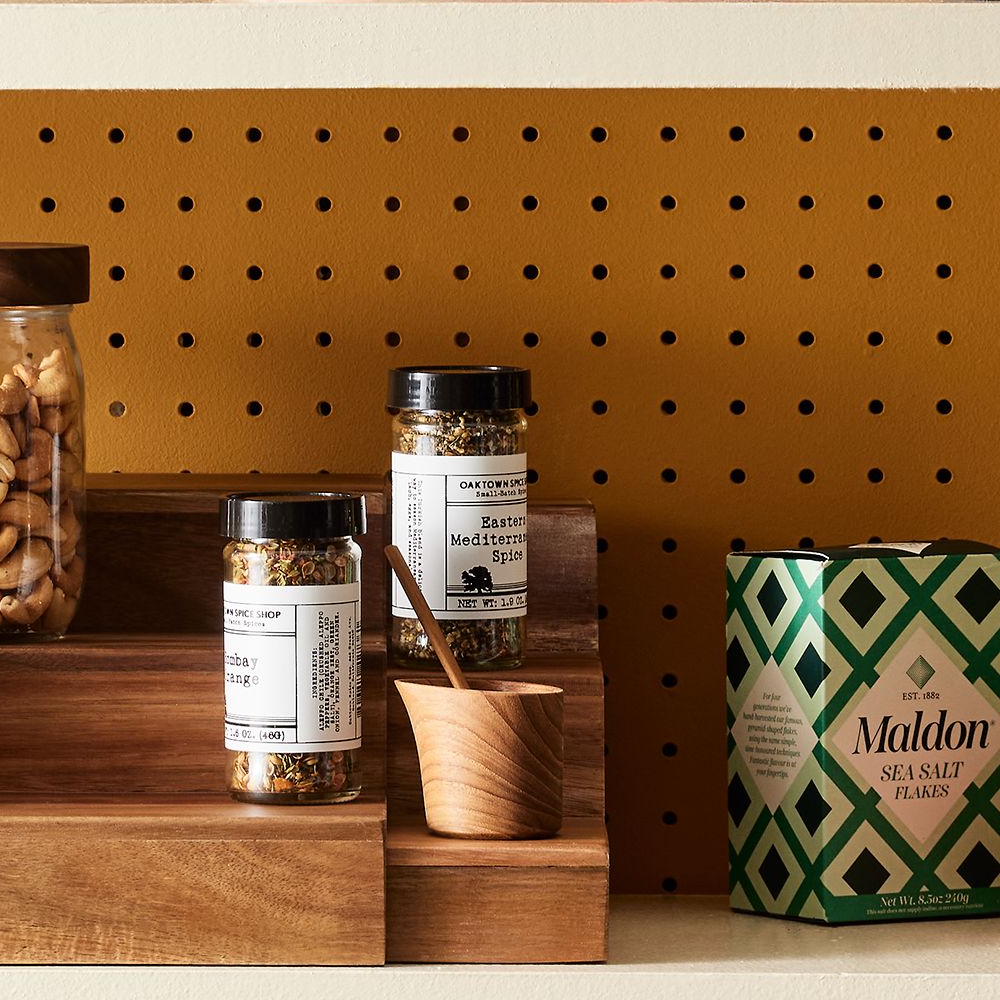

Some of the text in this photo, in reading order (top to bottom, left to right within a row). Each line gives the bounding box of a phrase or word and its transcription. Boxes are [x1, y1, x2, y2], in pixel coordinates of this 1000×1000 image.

[460, 480, 508, 490] OAKTOWN
[492, 549, 523, 564] Spice
[458, 599, 477, 608] NET
[482, 599, 498, 608] WT:
[234, 609, 254, 618] SPICE
[256, 610, 281, 619] SHOP
[225, 652, 258, 670] mbay
[225, 673, 259, 688] range
[902, 692, 940, 700] EST. 1882
[851, 709, 990, 755] Maldon
[880, 761, 964, 782] SEA SALT
[895, 784, 950, 800] FLAKES
[880, 892, 969, 907] Net Wt. 8.5oz 240g
